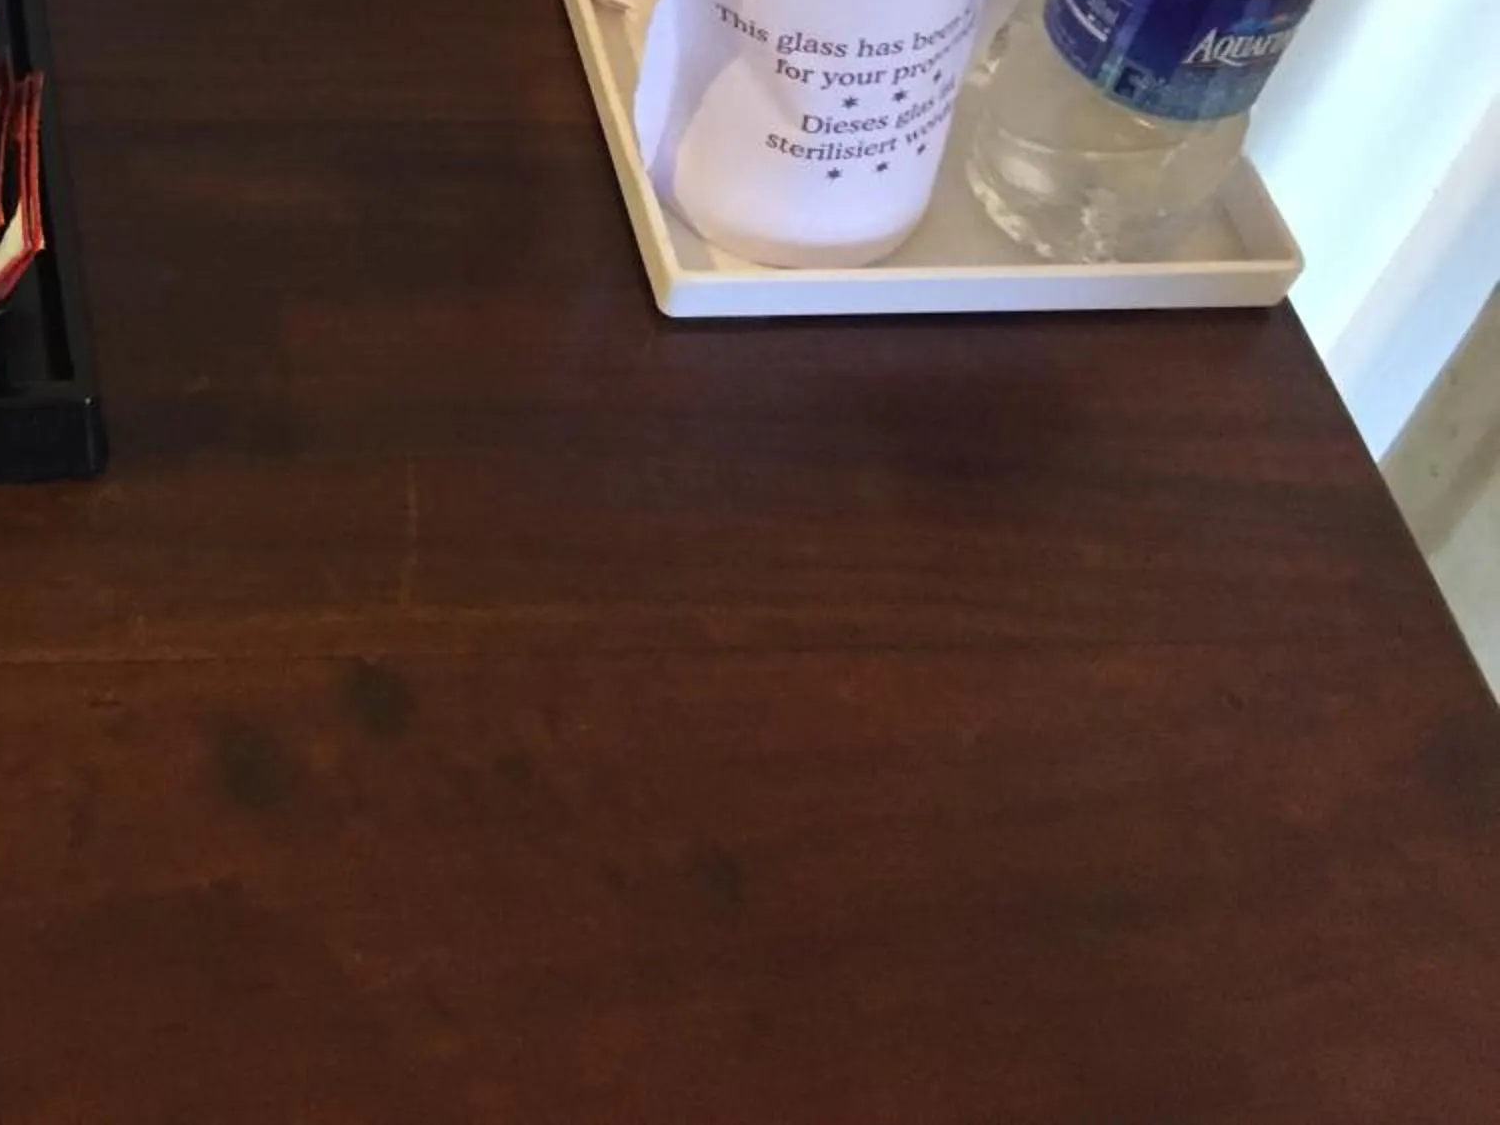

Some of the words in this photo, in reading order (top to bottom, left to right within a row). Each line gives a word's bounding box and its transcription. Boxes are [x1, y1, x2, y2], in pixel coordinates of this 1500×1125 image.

[714, 3, 769, 43] This
[775, 31, 848, 57] glass
[857, 38, 904, 58] has
[774, 58, 815, 84] for
[819, 70, 887, 91] your
[800, 114, 890, 135] Dieses
[765, 133, 898, 162] sterilisiert
